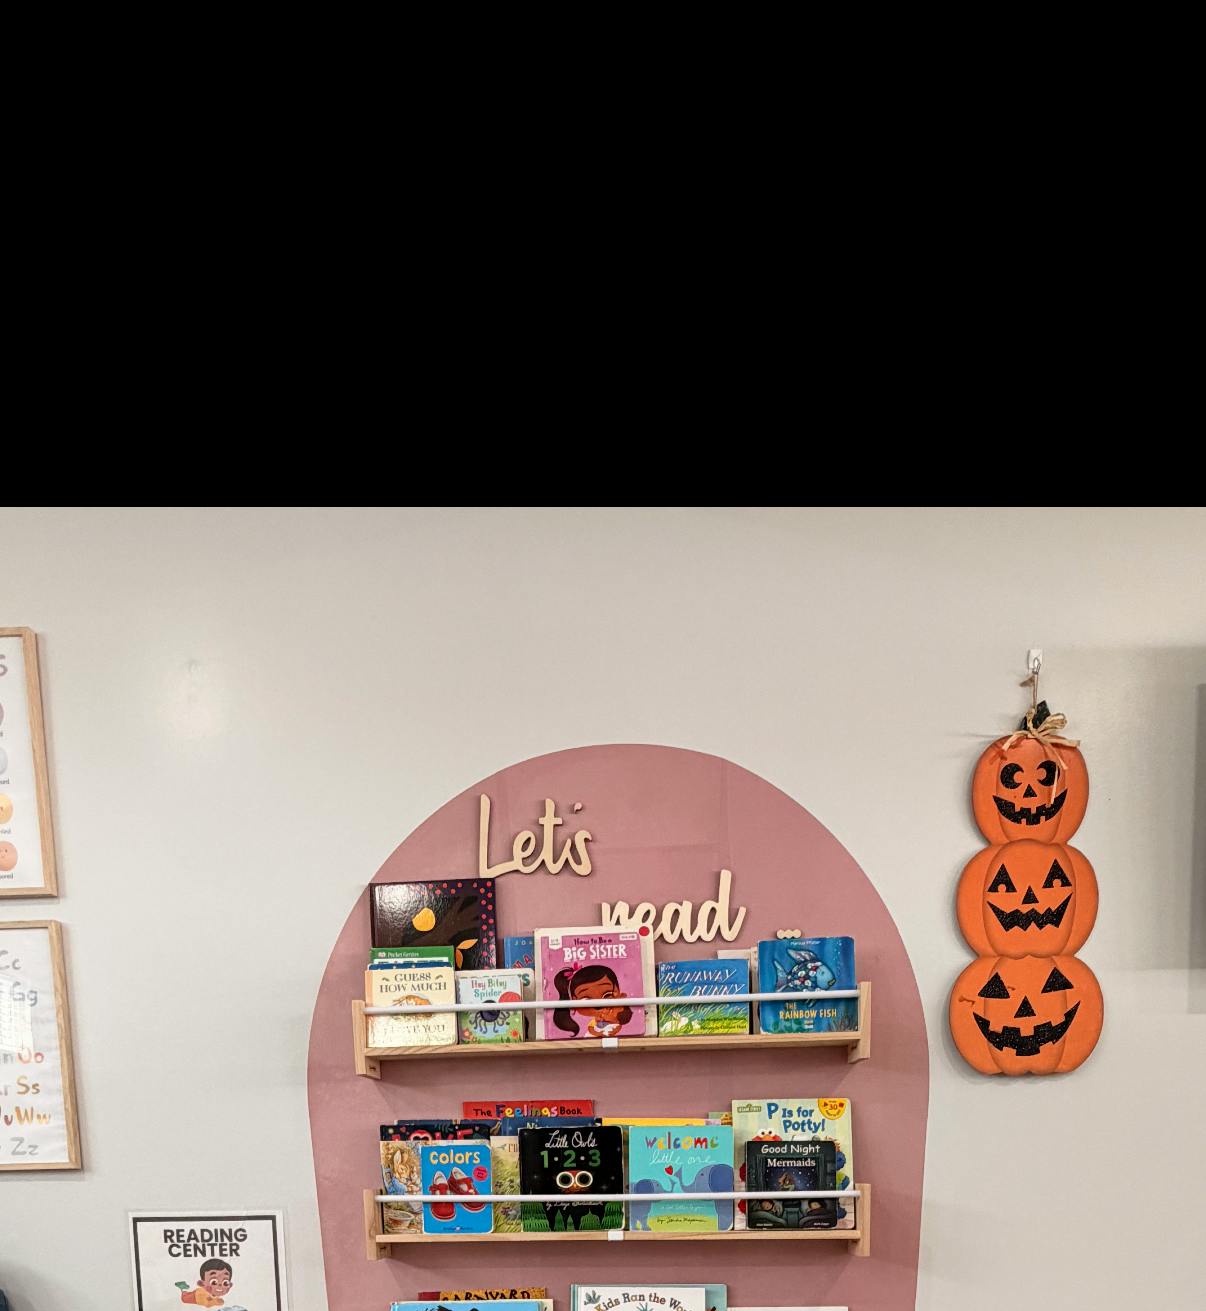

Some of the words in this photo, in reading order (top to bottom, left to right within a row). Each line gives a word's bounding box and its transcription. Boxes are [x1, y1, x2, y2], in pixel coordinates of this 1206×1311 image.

[479, 793, 593, 878] Let's
[394, 972, 432, 981] GUESS
[662, 969, 737, 984] RUNAWAY
[379, 983, 408, 993] HOW
[410, 982, 447, 992] MUCH
[474, 989, 502, 1000] Spider
[689, 984, 745, 996] BUNNY
[779, 1009, 817, 1019] RAINBOW
[819, 1008, 837, 1018] FISH
[422, 1024, 445, 1033] YOU
[16, 1075, 40, 1095] Ss
[15, 1106, 51, 1125] Ww
[473, 1108, 492, 1117] The
[495, 1103, 558, 1118] Feelings
[559, 1106, 582, 1116] Book
[767, 1102, 779, 1119] P
[782, 1108, 793, 1118] Is
[797, 1107, 814, 1118] for
[783, 1119, 826, 1134] Potty!
[10, 1137, 39, 1156] Zz
[545, 1130, 570, 1149] Little
[645, 1132, 719, 1150] welcome
[430, 1149, 480, 1164] colors
[649, 1150, 683, 1165] little
[688, 1155, 717, 1164] one
[761, 1144, 787, 1154] Good
[790, 1144, 820, 1156] Night
[767, 1158, 816, 1168] Mermaids
[163, 1228, 248, 1244] READING
[168, 1243, 240, 1258] CENTER
[622, 1292, 646, 1304] Ran
[648, 1292, 667, 1305] the
